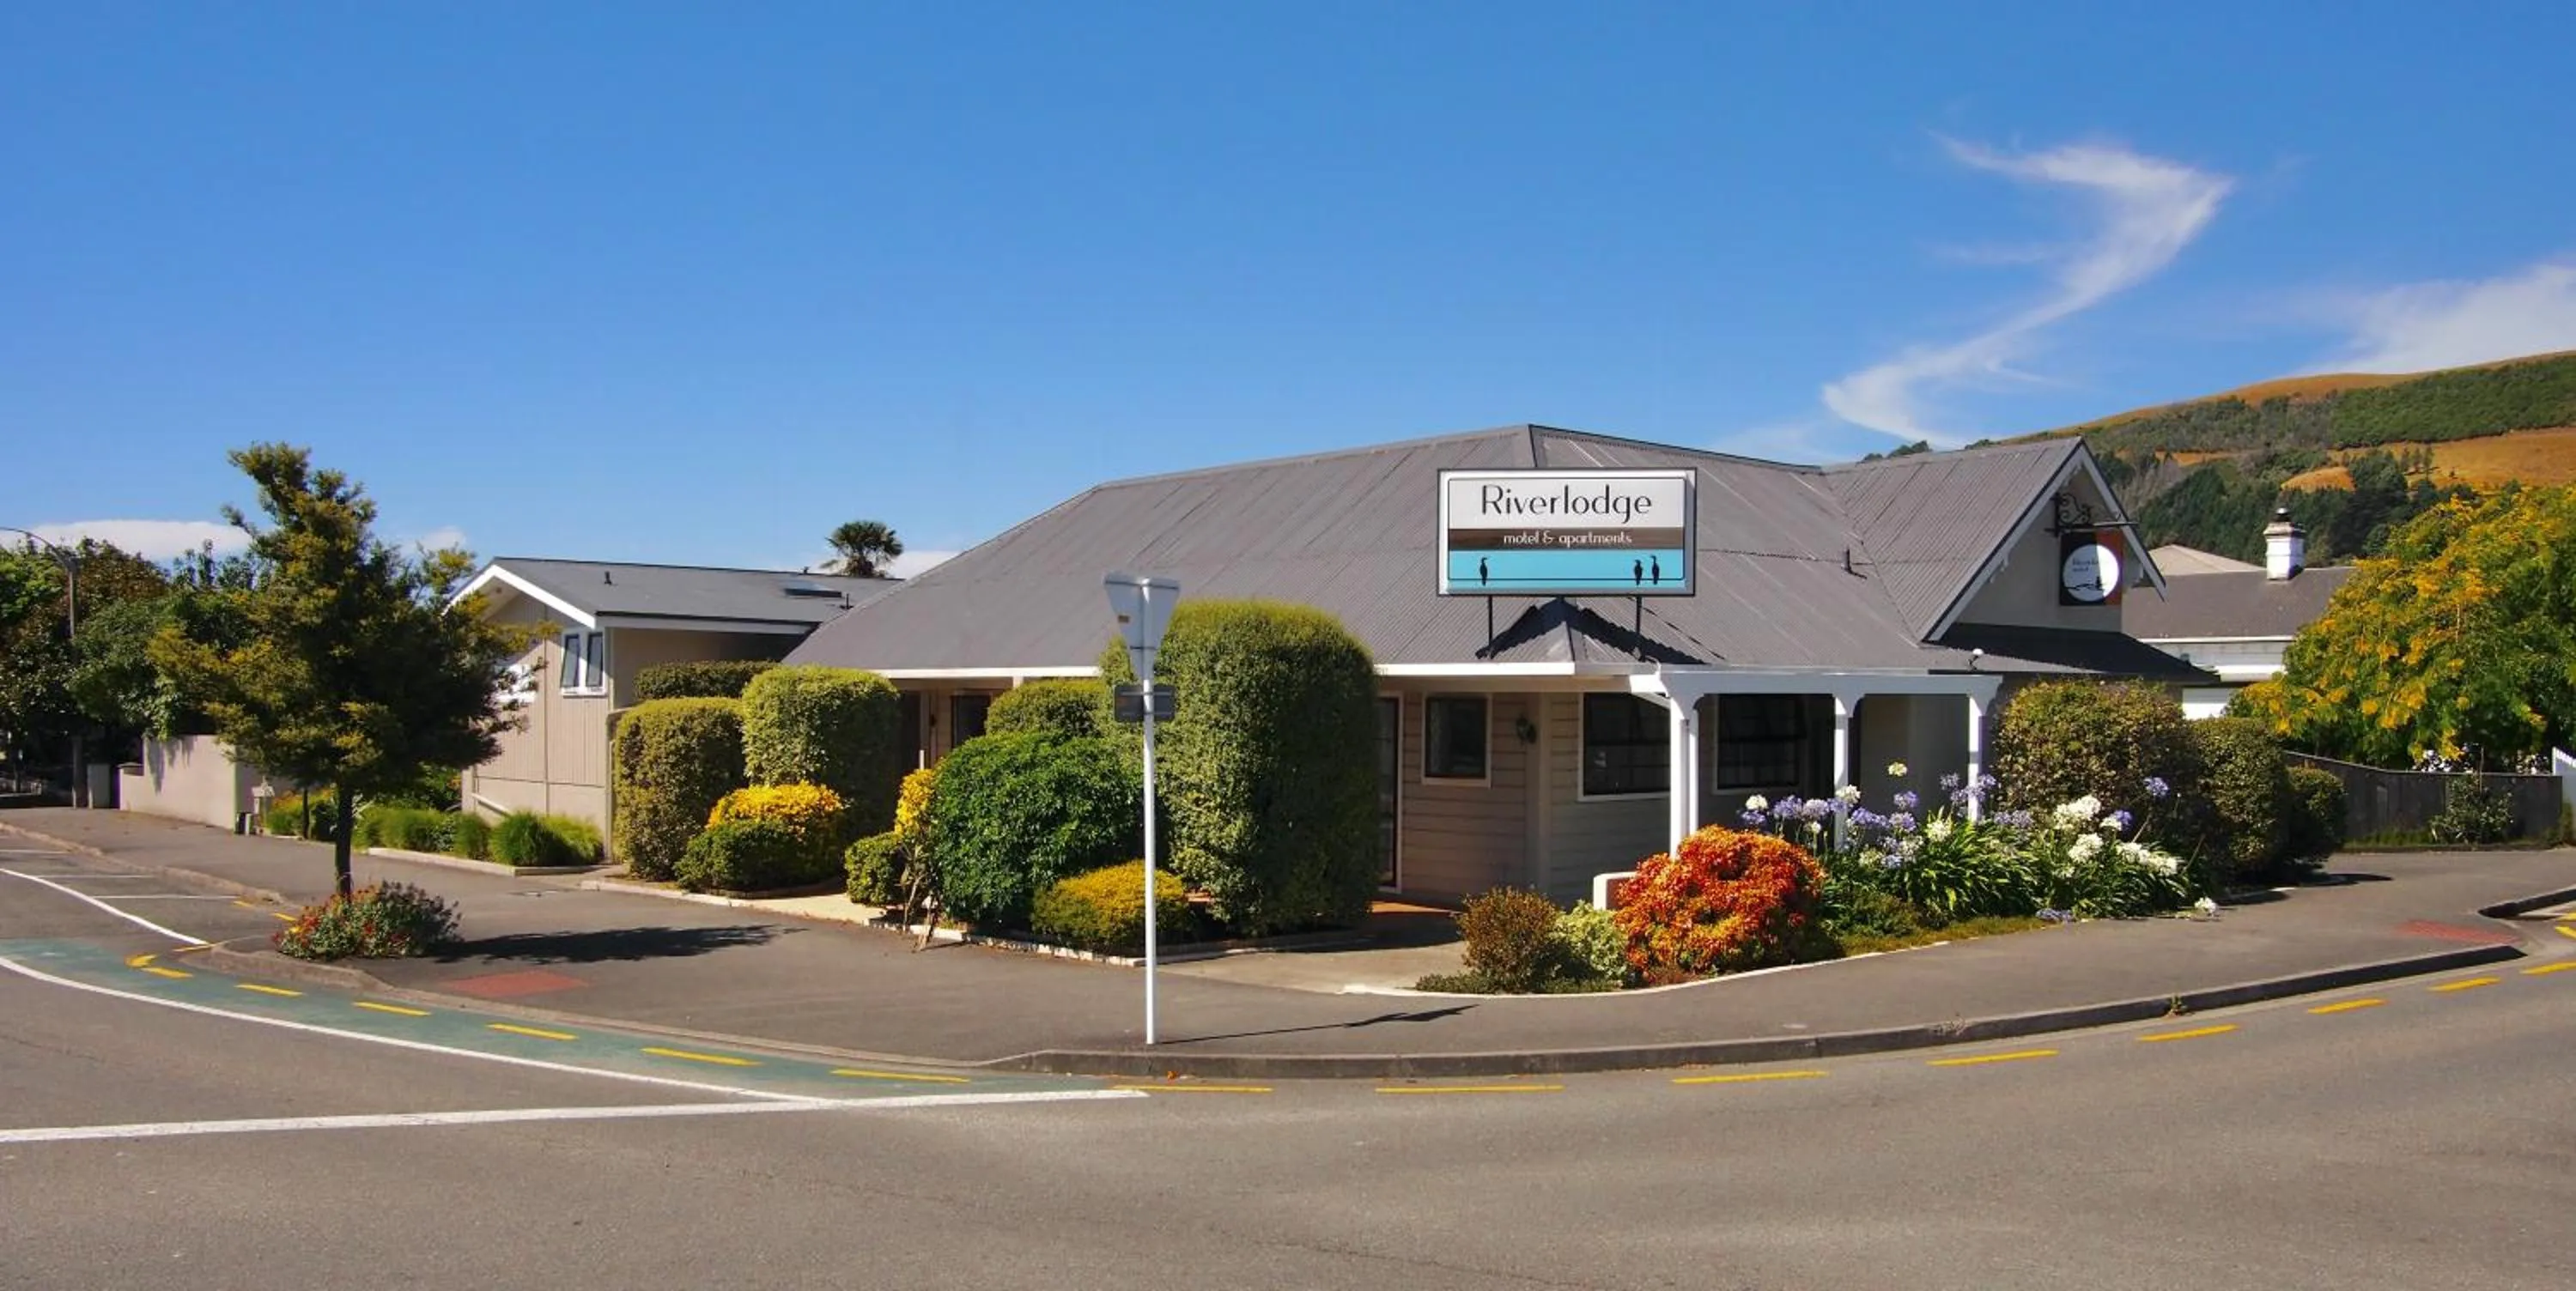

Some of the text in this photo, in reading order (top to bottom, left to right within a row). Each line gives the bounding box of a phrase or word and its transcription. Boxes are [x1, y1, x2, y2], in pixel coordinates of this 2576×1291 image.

[1482, 484, 1652, 524] Riverlodge
[1504, 530, 1632, 548] motel & apartments
